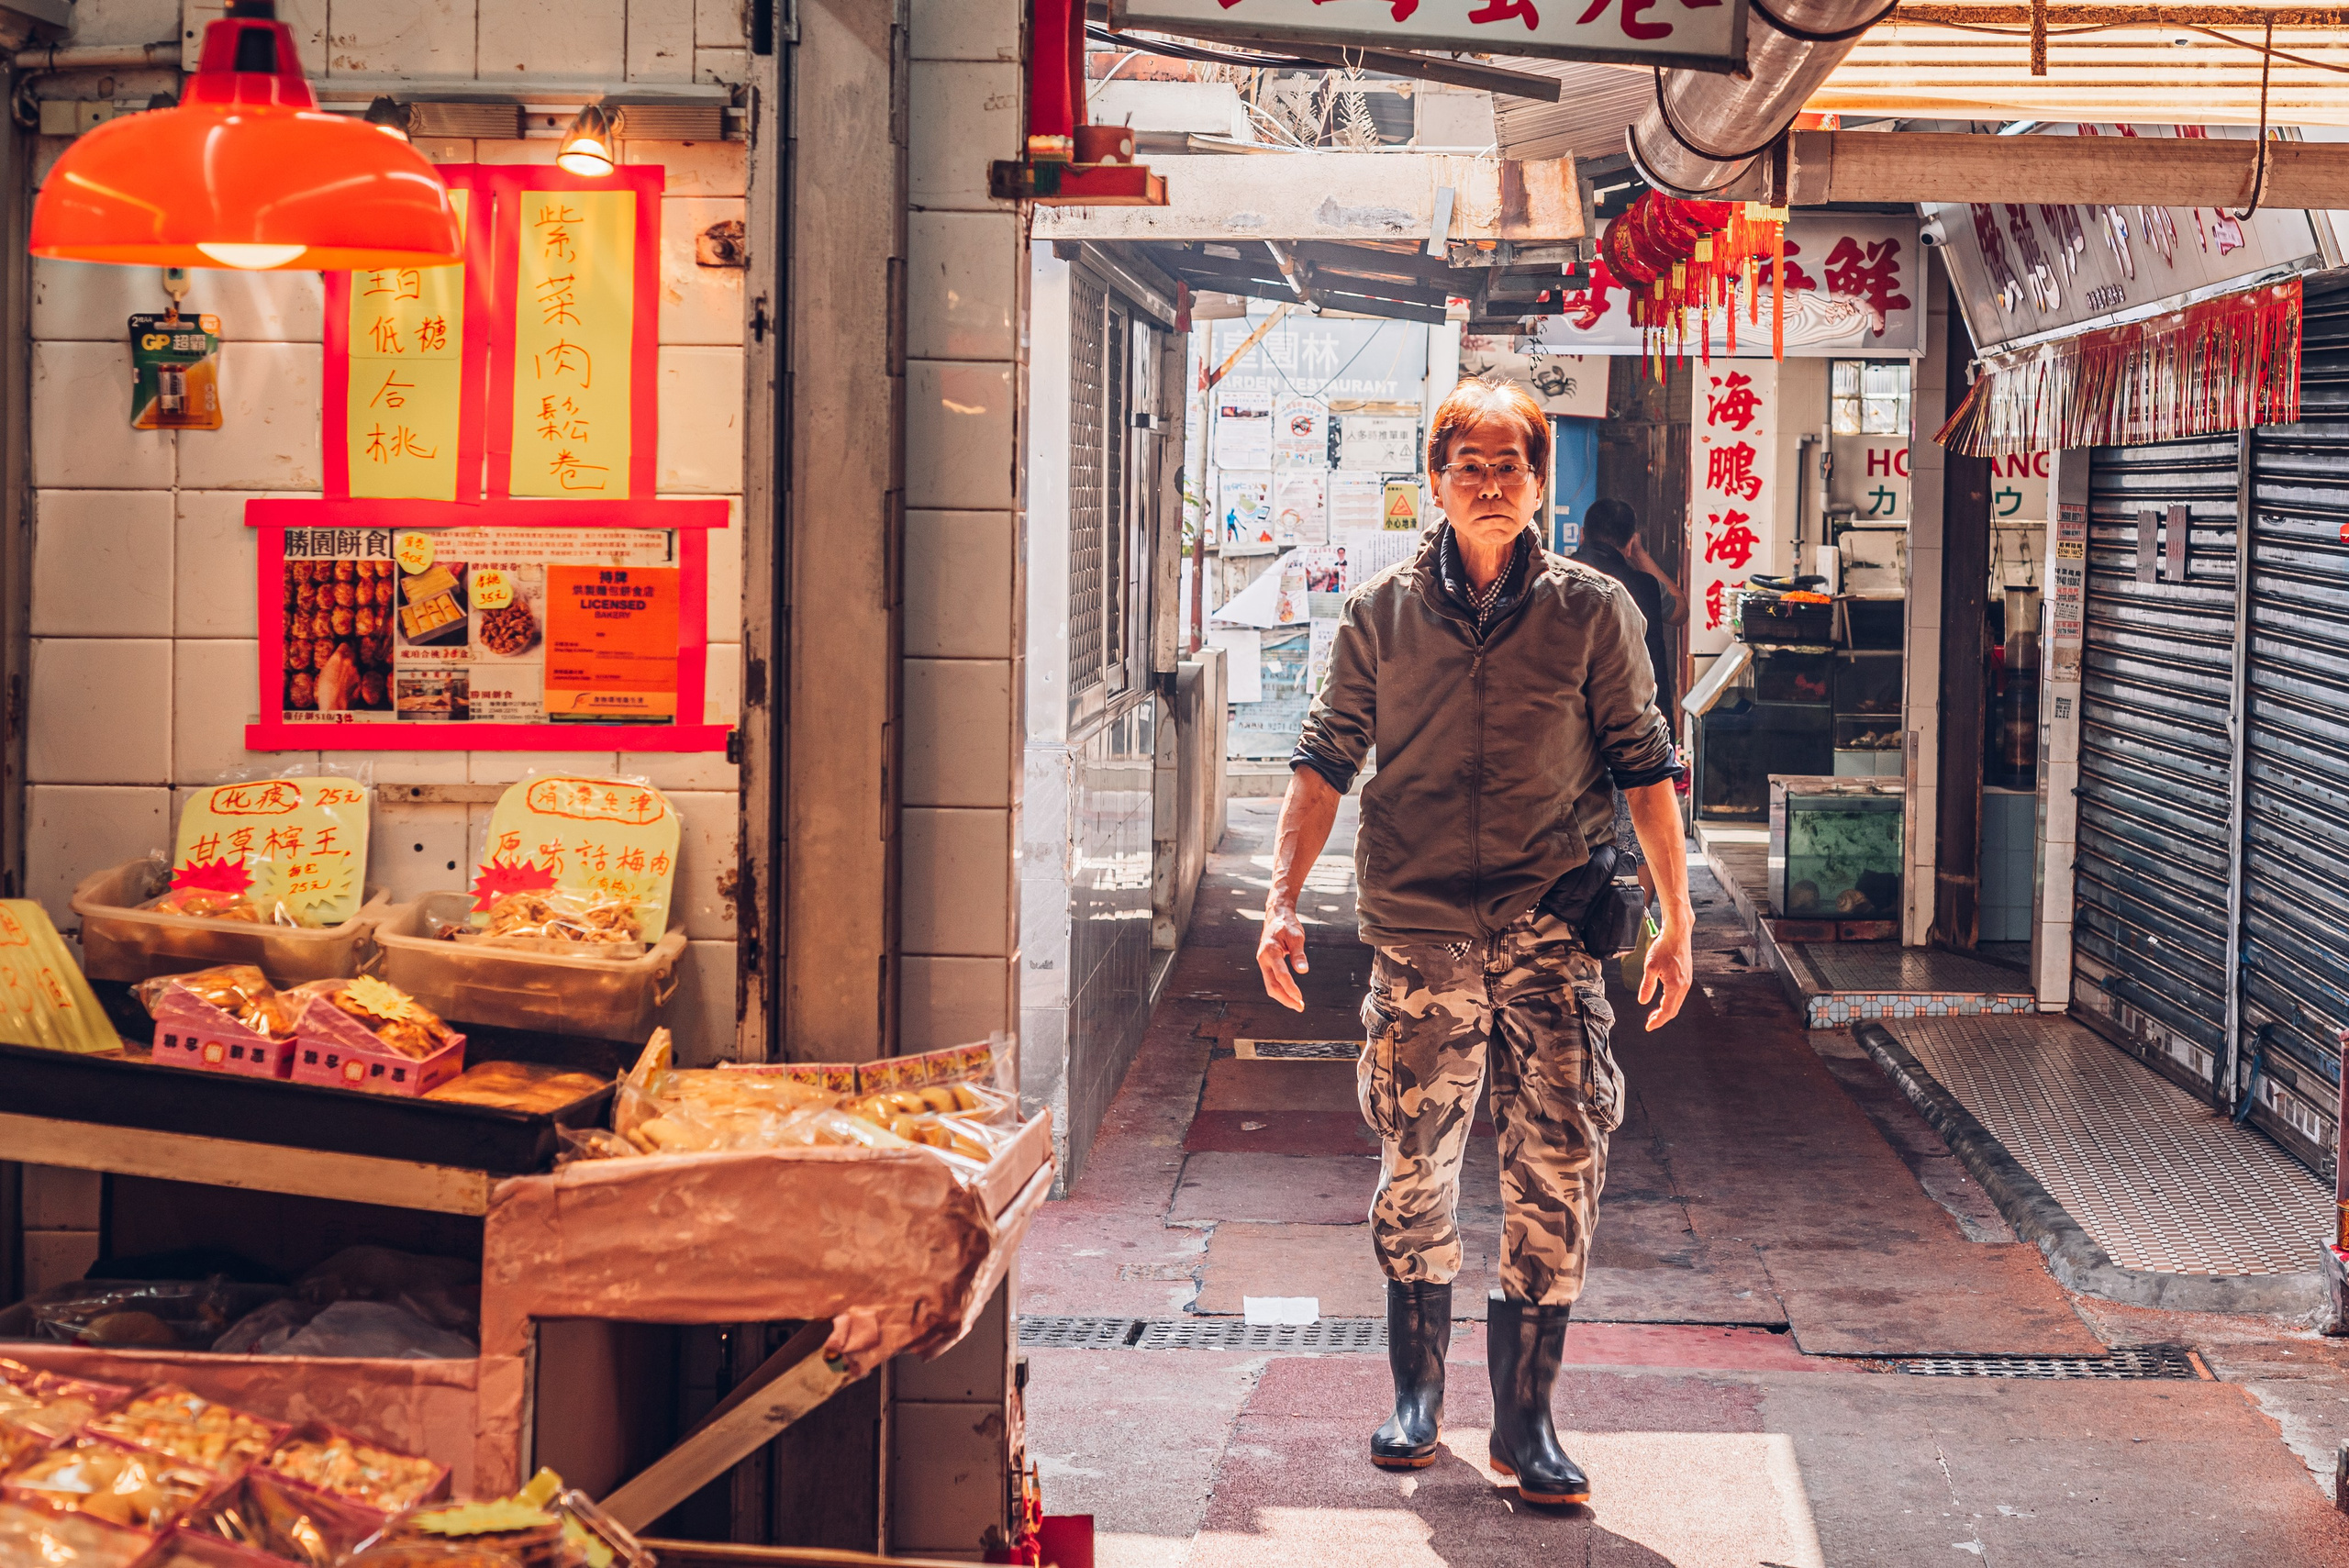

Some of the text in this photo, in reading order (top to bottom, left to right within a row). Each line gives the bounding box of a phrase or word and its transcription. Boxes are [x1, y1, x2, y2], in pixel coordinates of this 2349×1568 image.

[141, 334, 171, 350] GP
[173, 334, 206, 350] 超霸
[369, 315, 447, 354] 低糖
[534, 205, 609, 490] 紫菜肉鬆卷
[1206, 374, 1280, 393] ARDEN
[366, 369, 438, 464] 合桃
[1867, 484, 2022, 517] カ ウ
[284, 529, 389, 557] 勝園餅食
[599, 571, 628, 584] 持牌
[580, 599, 646, 610] LICENSED
[595, 611, 630, 619] BAKERY
[221, 786, 362, 810] 化痰 25元
[289, 878, 331, 895] 25元
